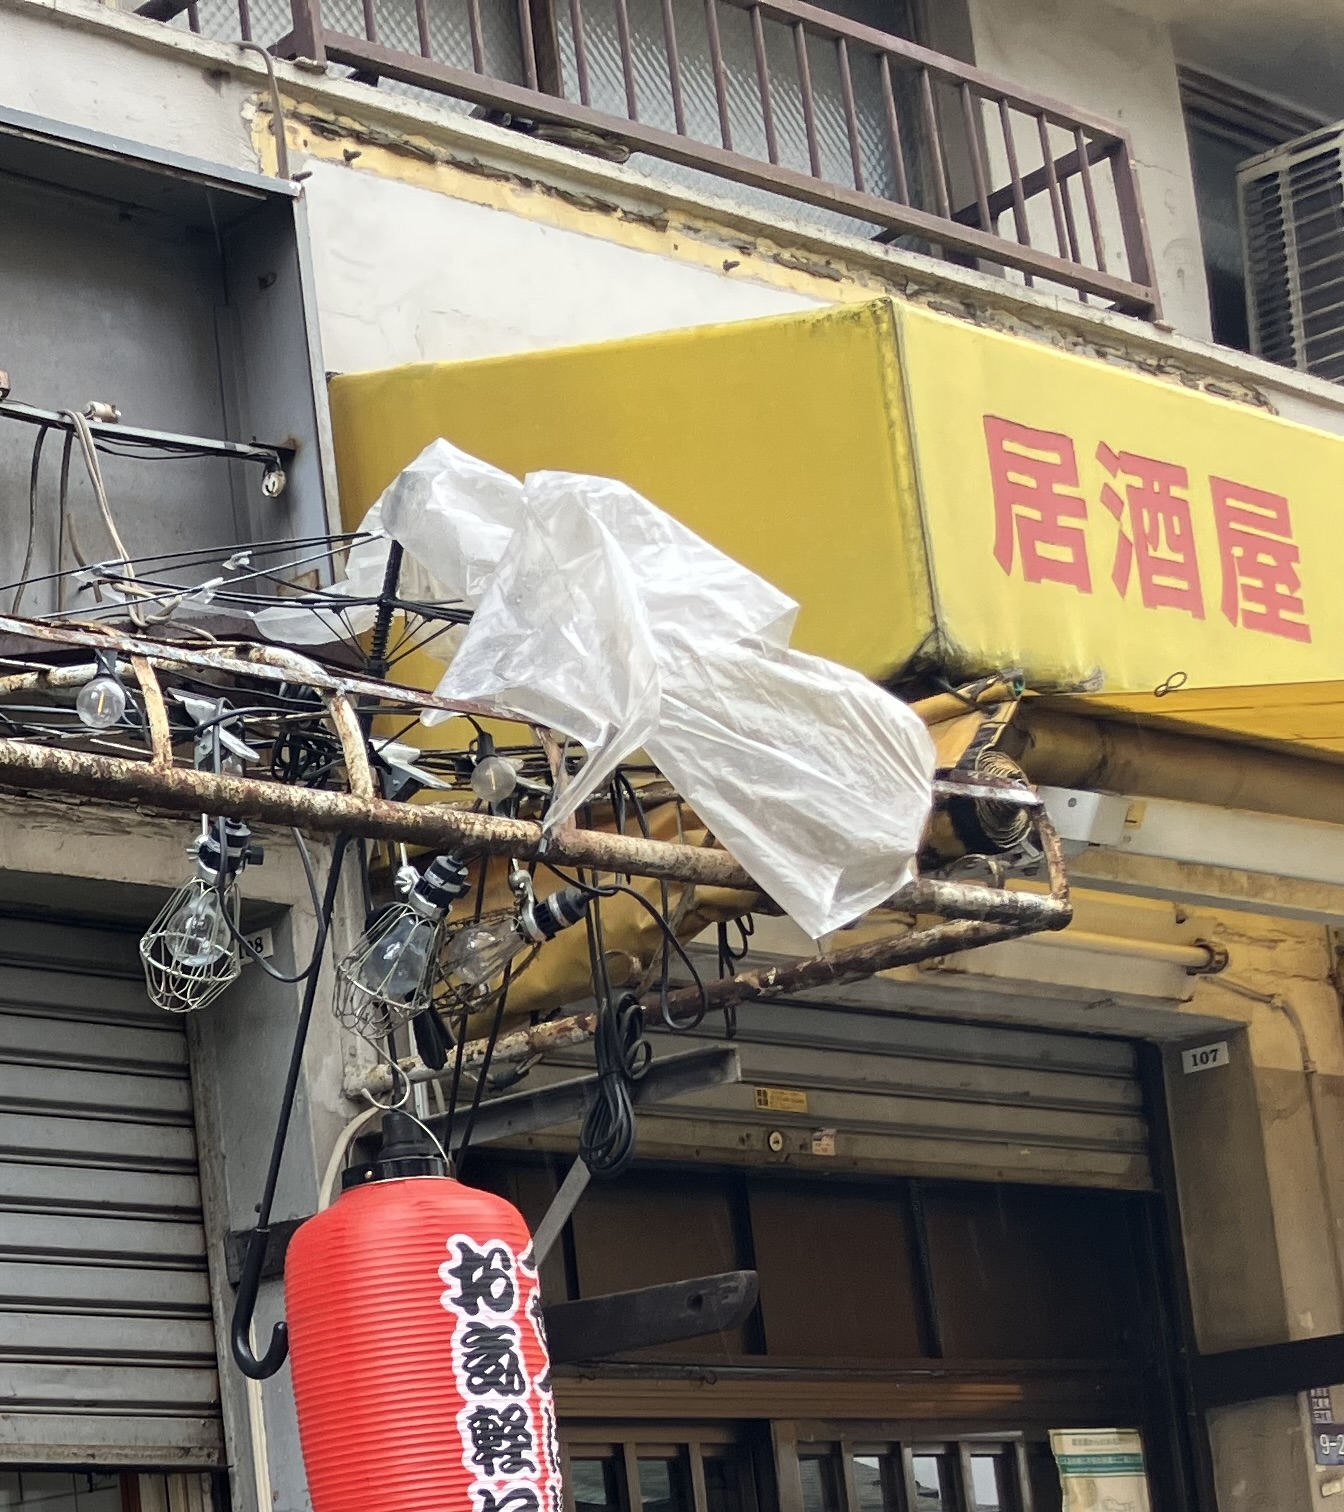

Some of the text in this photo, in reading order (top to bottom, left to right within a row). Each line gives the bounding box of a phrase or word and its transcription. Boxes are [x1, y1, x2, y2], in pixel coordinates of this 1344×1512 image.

[983, 414, 1312, 644] 居酒屋
[1191, 1049, 1218, 1067] 107
